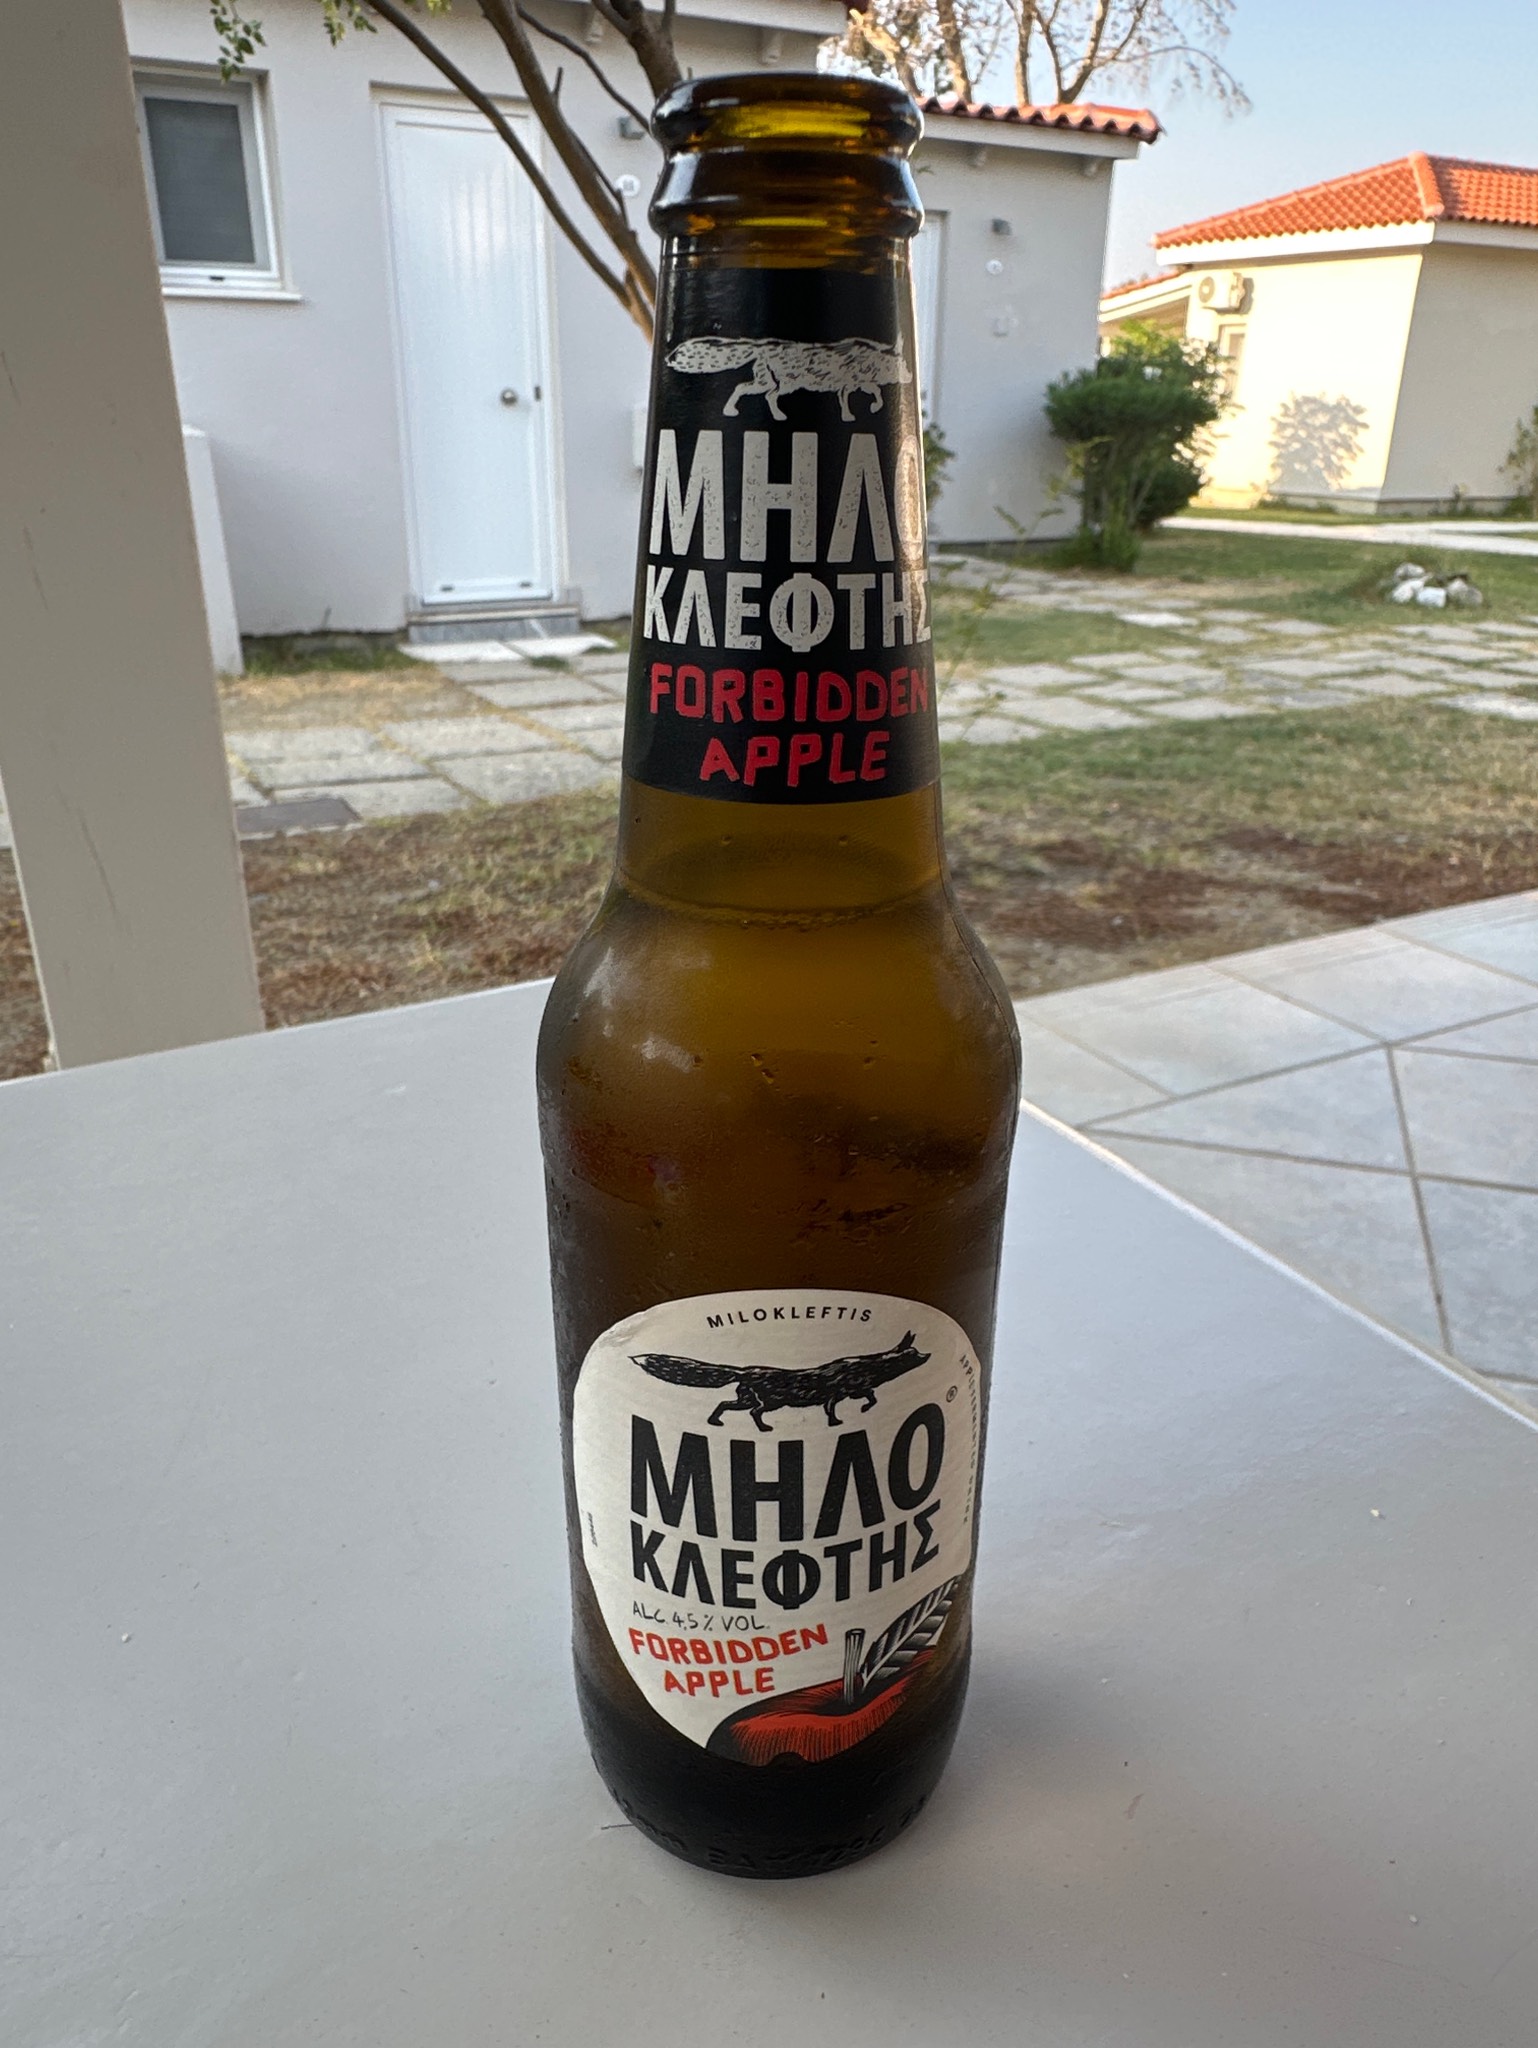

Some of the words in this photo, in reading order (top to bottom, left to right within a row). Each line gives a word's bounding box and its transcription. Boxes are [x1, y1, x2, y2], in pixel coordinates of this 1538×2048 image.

[643, 565, 932, 652] ΚΛΕΦΤΗΣ
[649, 662, 929, 723] FORBIDDEN
[700, 731, 890, 787] APPLE
[706, 1305, 873, 1330] MILOKLEFTIS
[630, 1403, 945, 1542] ΜΗΛΟ
[629, 1499, 940, 1610] ΚΛΕΦΤΗΣ
[628, 1622, 829, 1666] FORBIDDEN
[664, 1667, 776, 1698] APPLE
